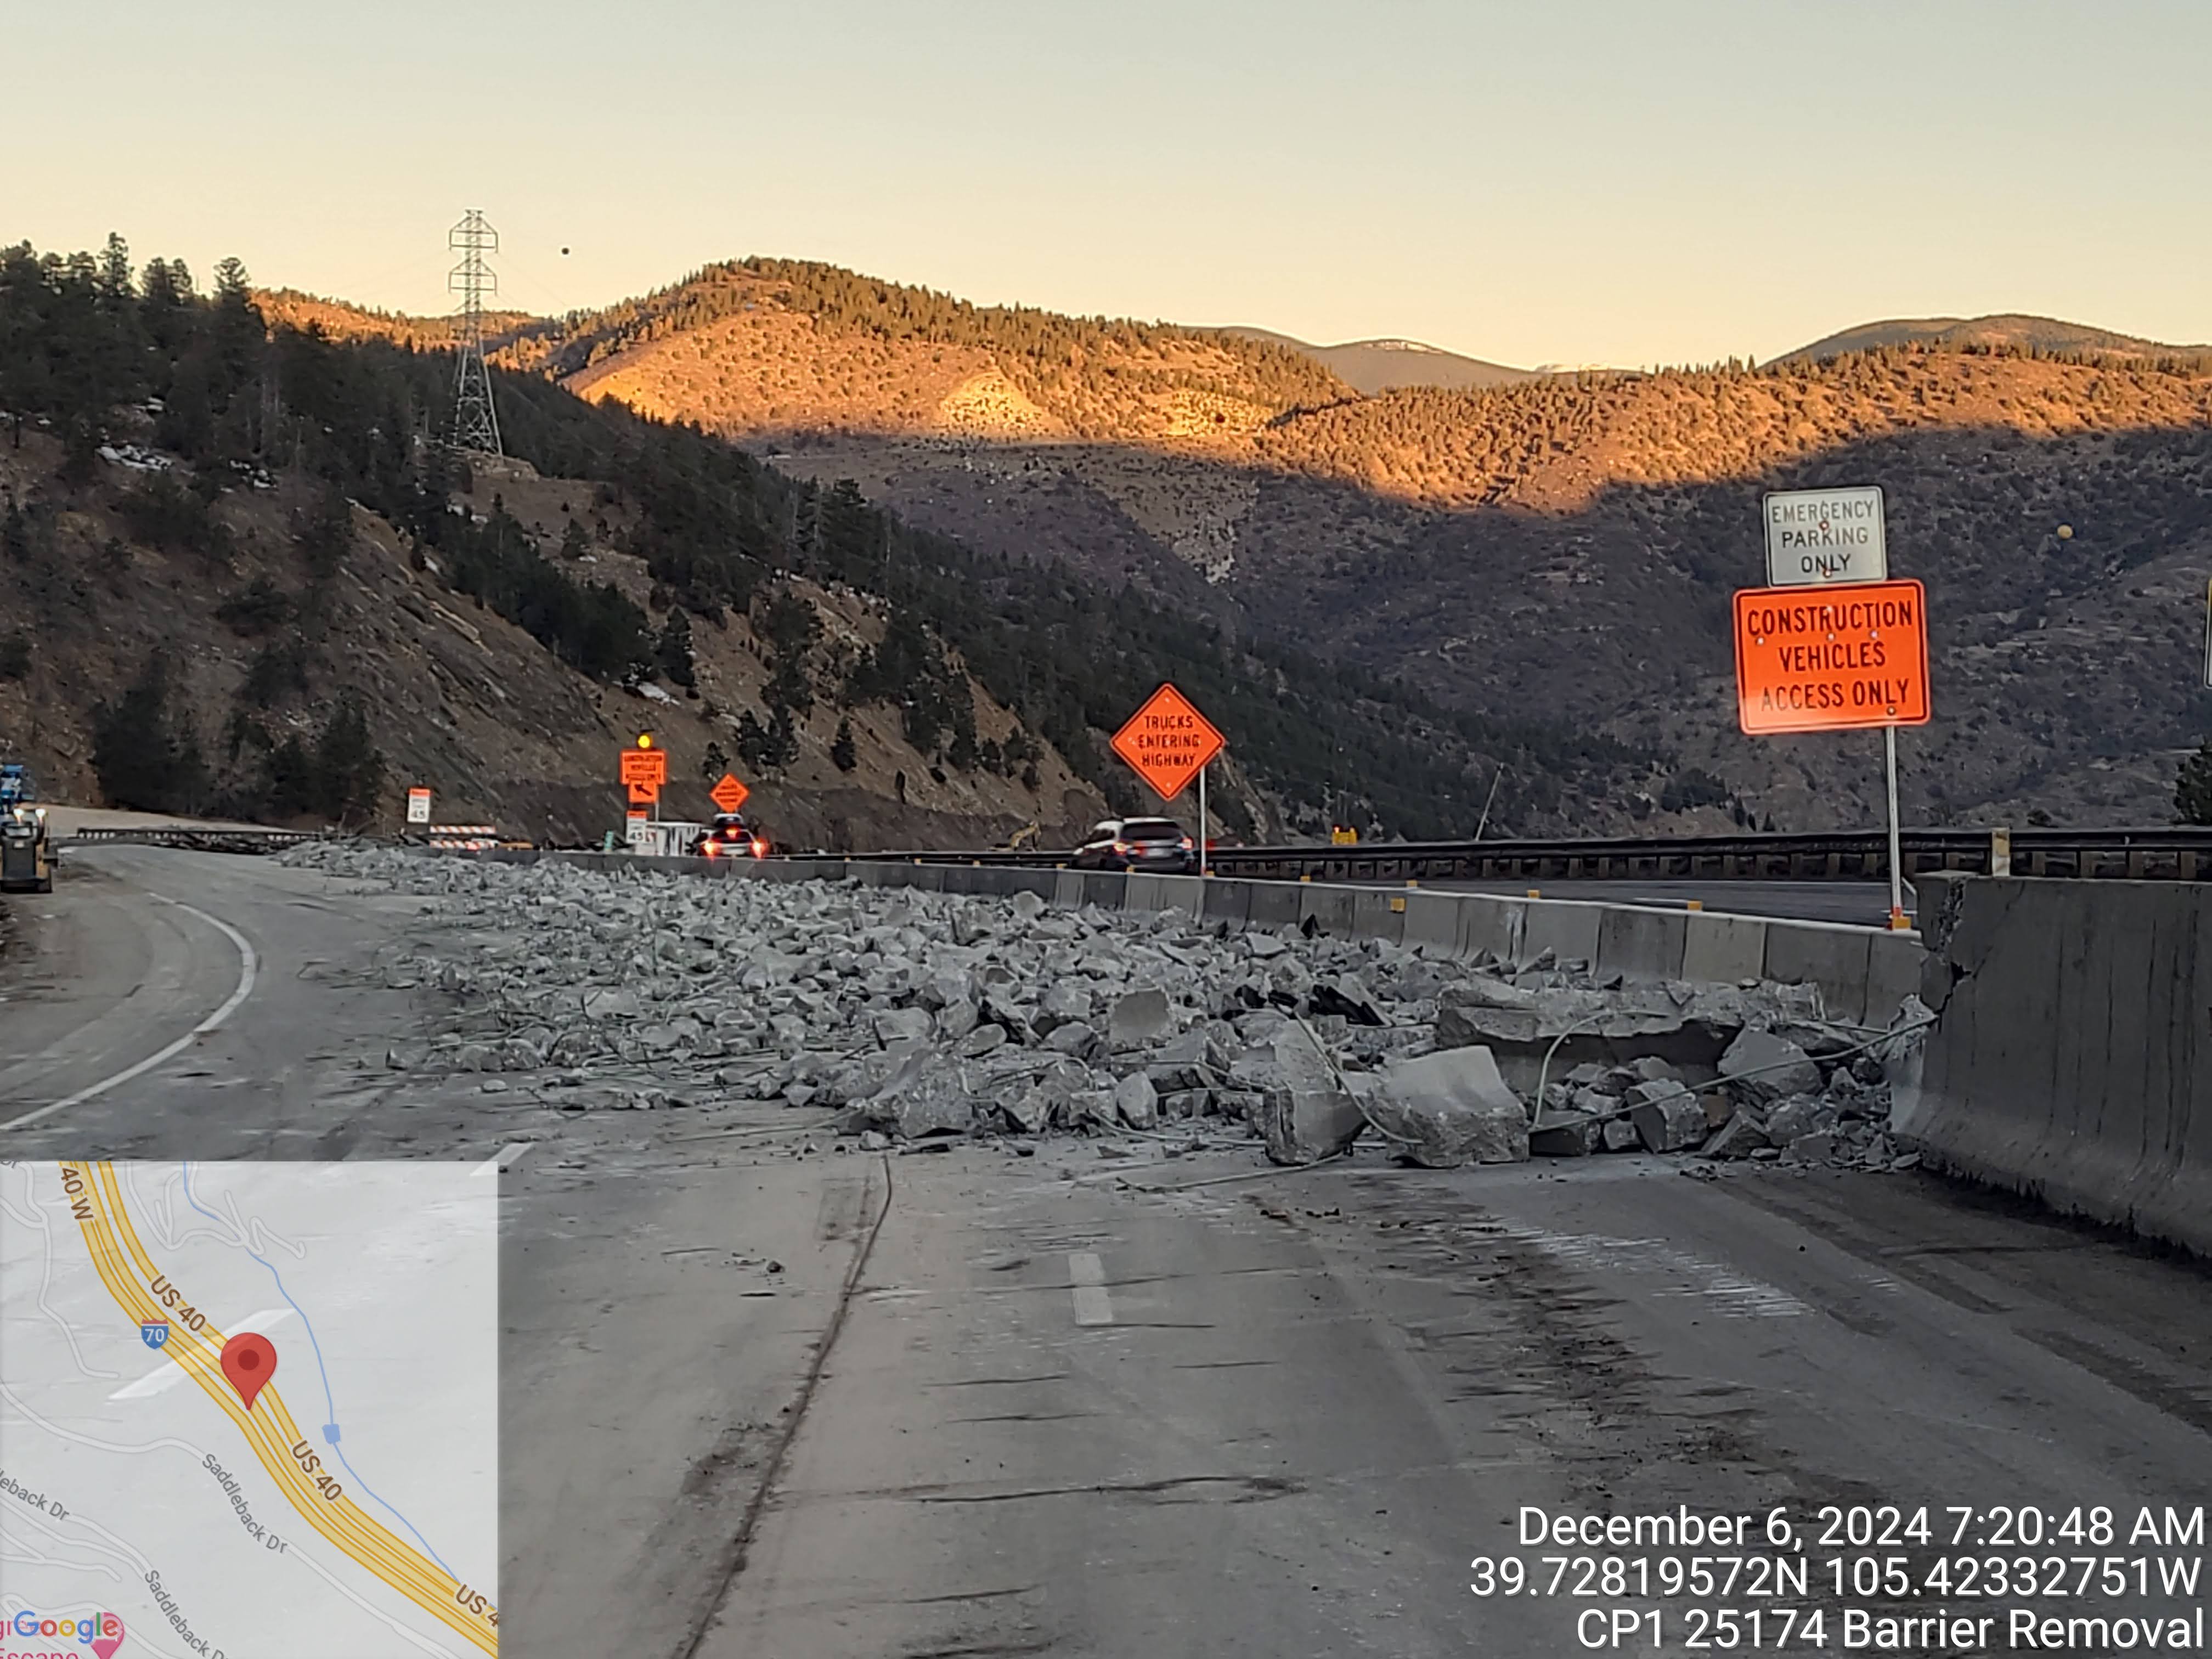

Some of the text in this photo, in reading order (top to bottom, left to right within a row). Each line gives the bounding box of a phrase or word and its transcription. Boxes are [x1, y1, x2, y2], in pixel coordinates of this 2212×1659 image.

[1771, 500, 1874, 523] EMERGENCY
[1782, 527, 1868, 548] PARKING
[1801, 554, 1851, 573] ONLY
[1748, 601, 1912, 635] CONSTRUCTION
[1779, 641, 1886, 673] VEHICLES
[1762, 678, 1909, 712] ACCESS ONLY
[1144, 715, 1193, 730] TRUCKS
[1138, 733, 1200, 749] ENTERING
[1142, 753, 1195, 767] HIGHWAY
